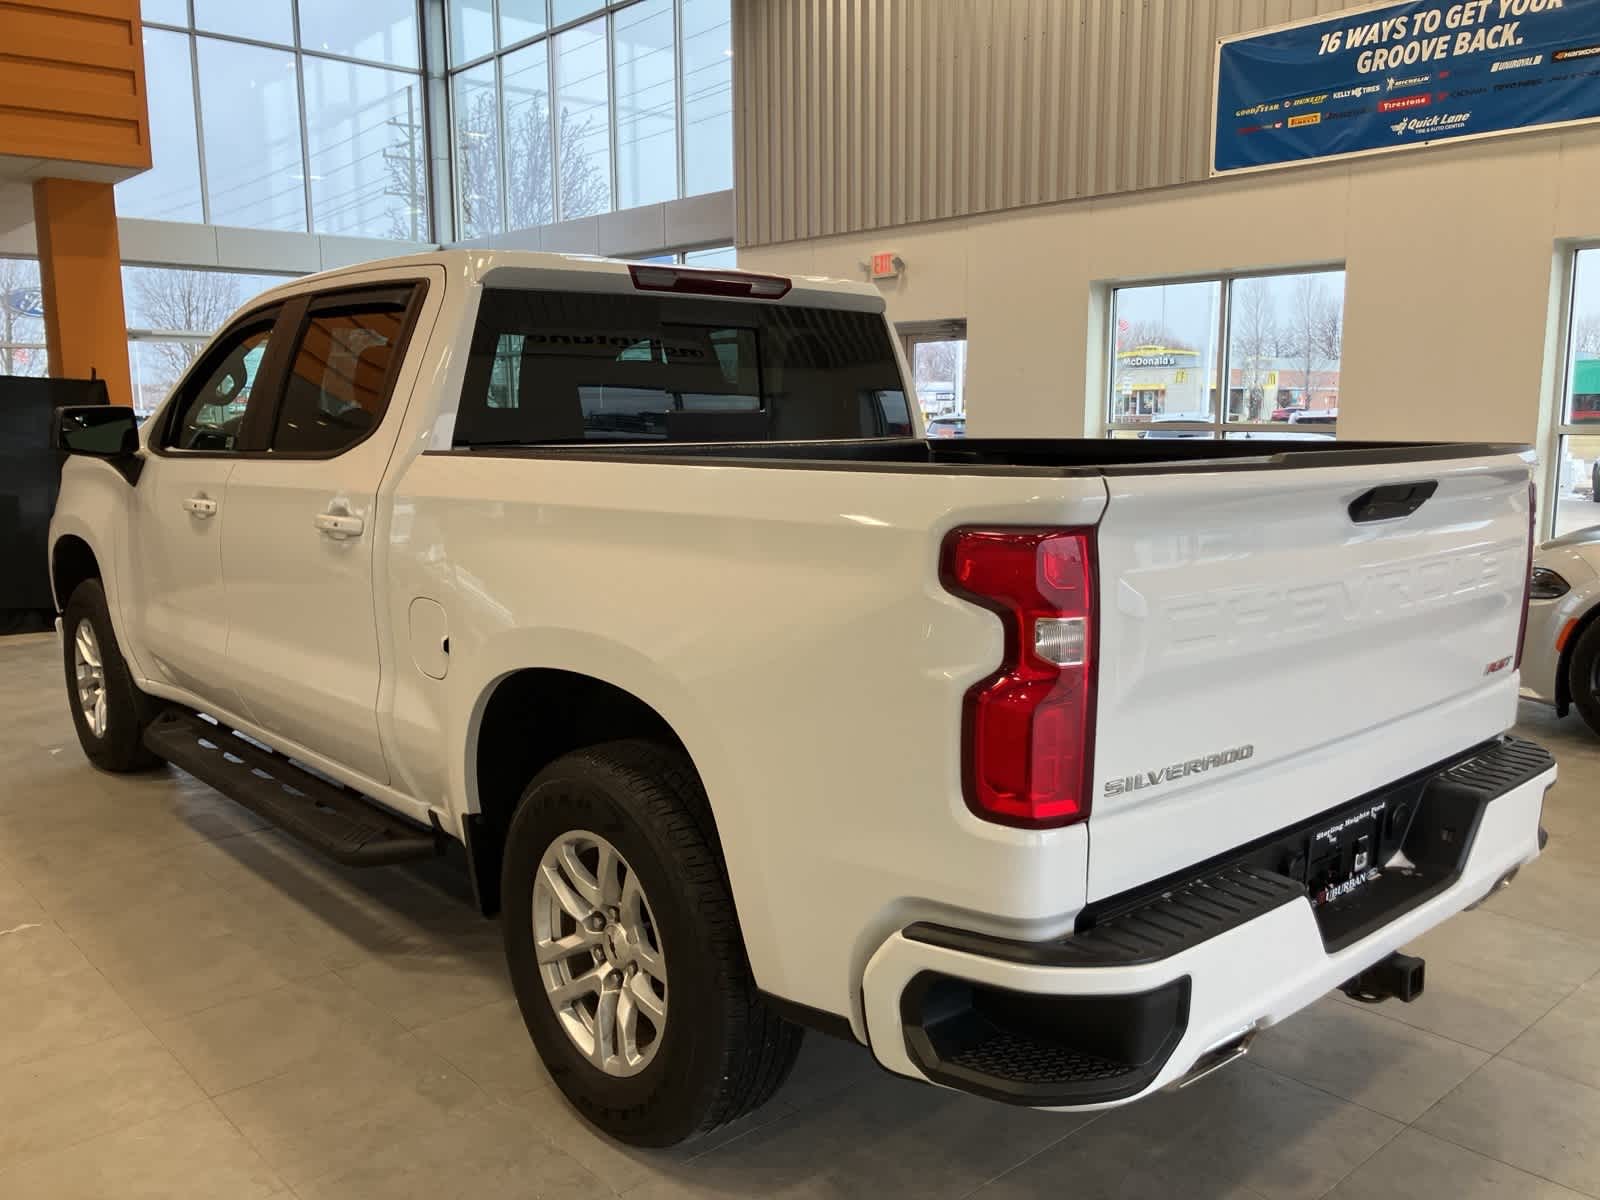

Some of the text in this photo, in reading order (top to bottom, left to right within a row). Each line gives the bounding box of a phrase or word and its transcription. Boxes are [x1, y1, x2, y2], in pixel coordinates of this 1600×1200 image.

[1318, 31, 1343, 56] 16
[1345, 16, 1408, 50] WAYS
[1412, 9, 1442, 36] TO
[1445, 0, 1493, 29] GET
[1356, 21, 1524, 74] GROOVE BACK.
[1333, 85, 1380, 100] KELLY TIRES
[1383, 97, 1427, 112] Firestone
[1407, 112, 1471, 131] Quick Lane
[1103, 743, 1255, 799] SILVERADO
